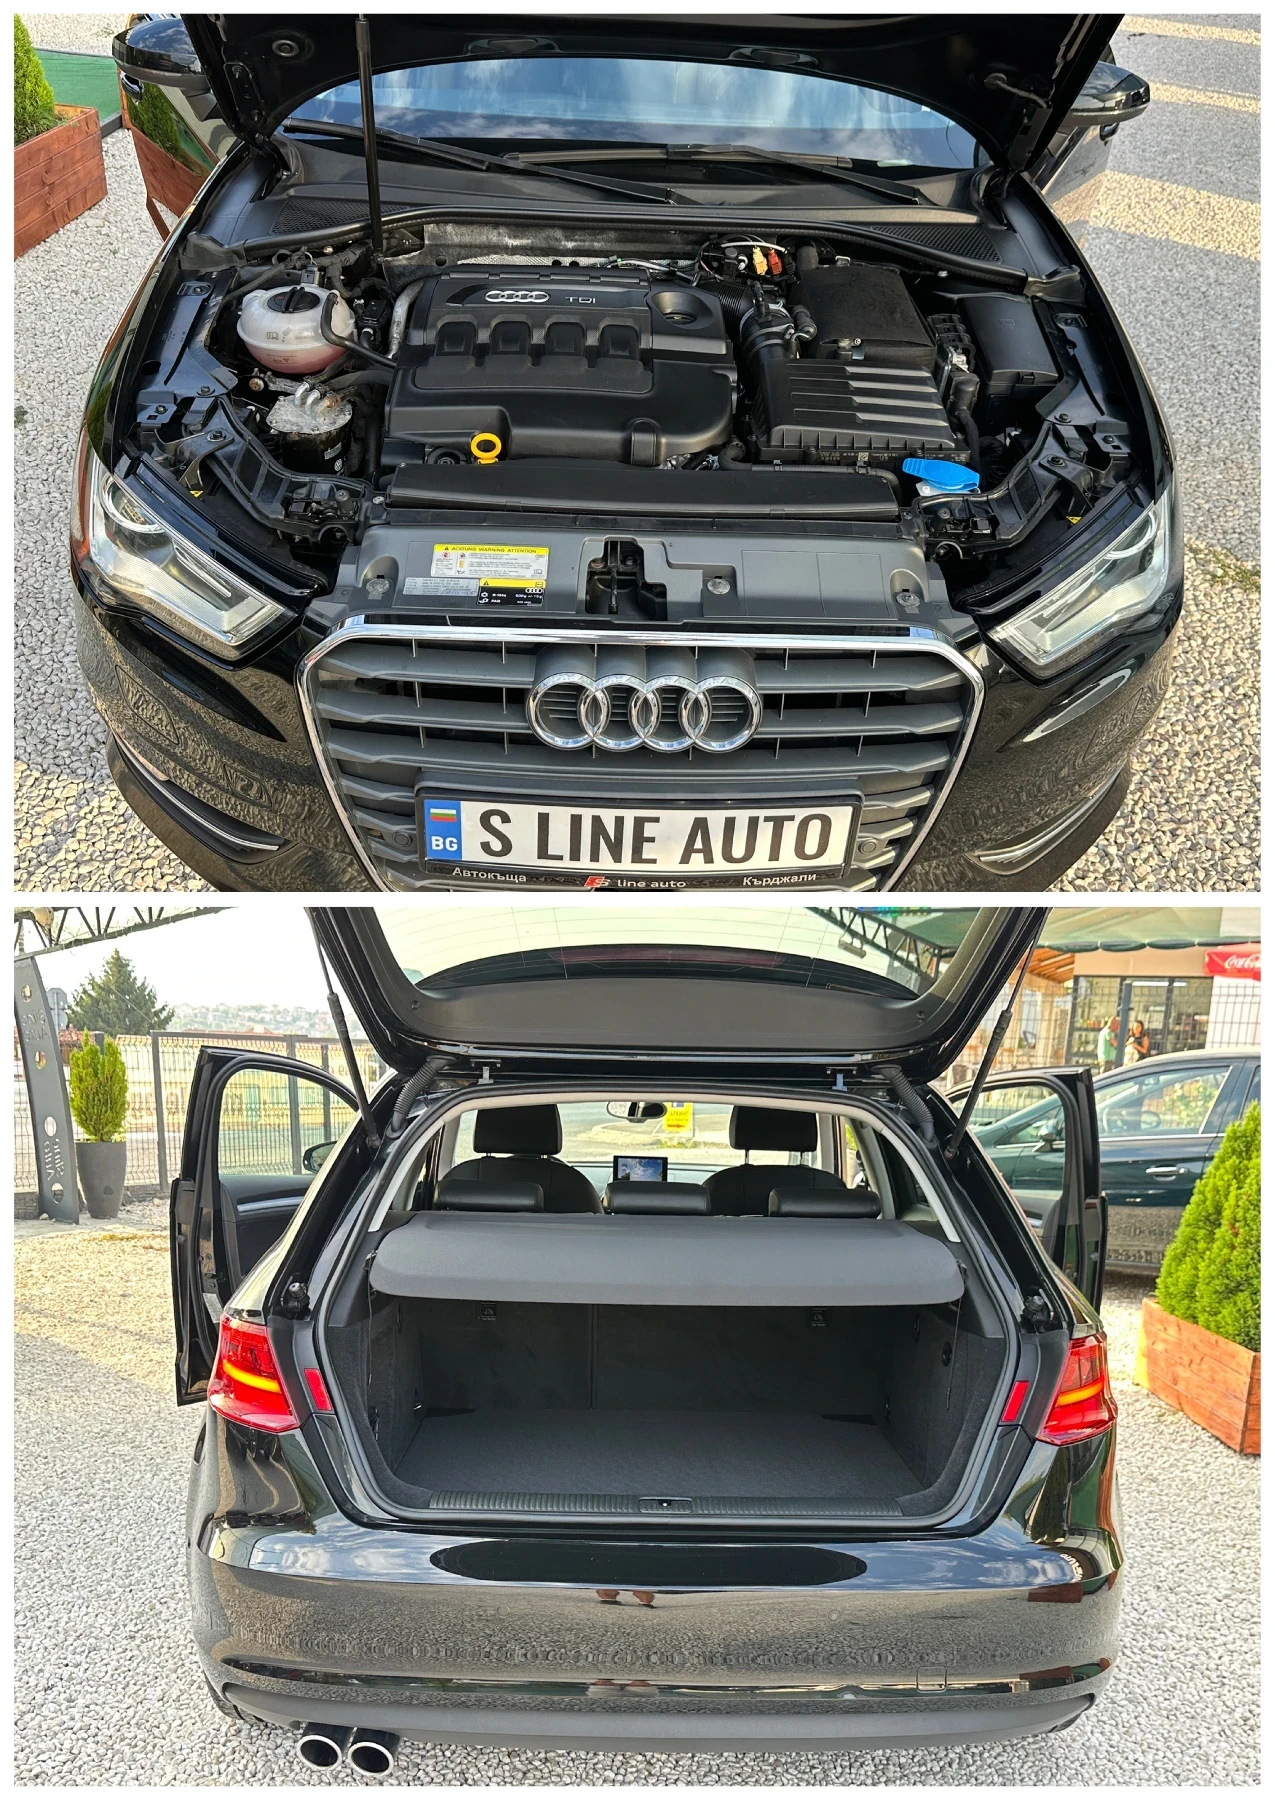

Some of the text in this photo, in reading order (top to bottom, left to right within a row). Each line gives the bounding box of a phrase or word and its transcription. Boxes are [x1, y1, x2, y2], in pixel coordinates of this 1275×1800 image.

[564, 296, 596, 304] TDI
[431, 836, 459, 852] BG
[478, 808, 833, 865] S LINE AUTO
[451, 866, 527, 883] Автокъща
[742, 872, 818, 888] Кърджали
[616, 878, 647, 889] line
[650, 880, 687, 889] auto
